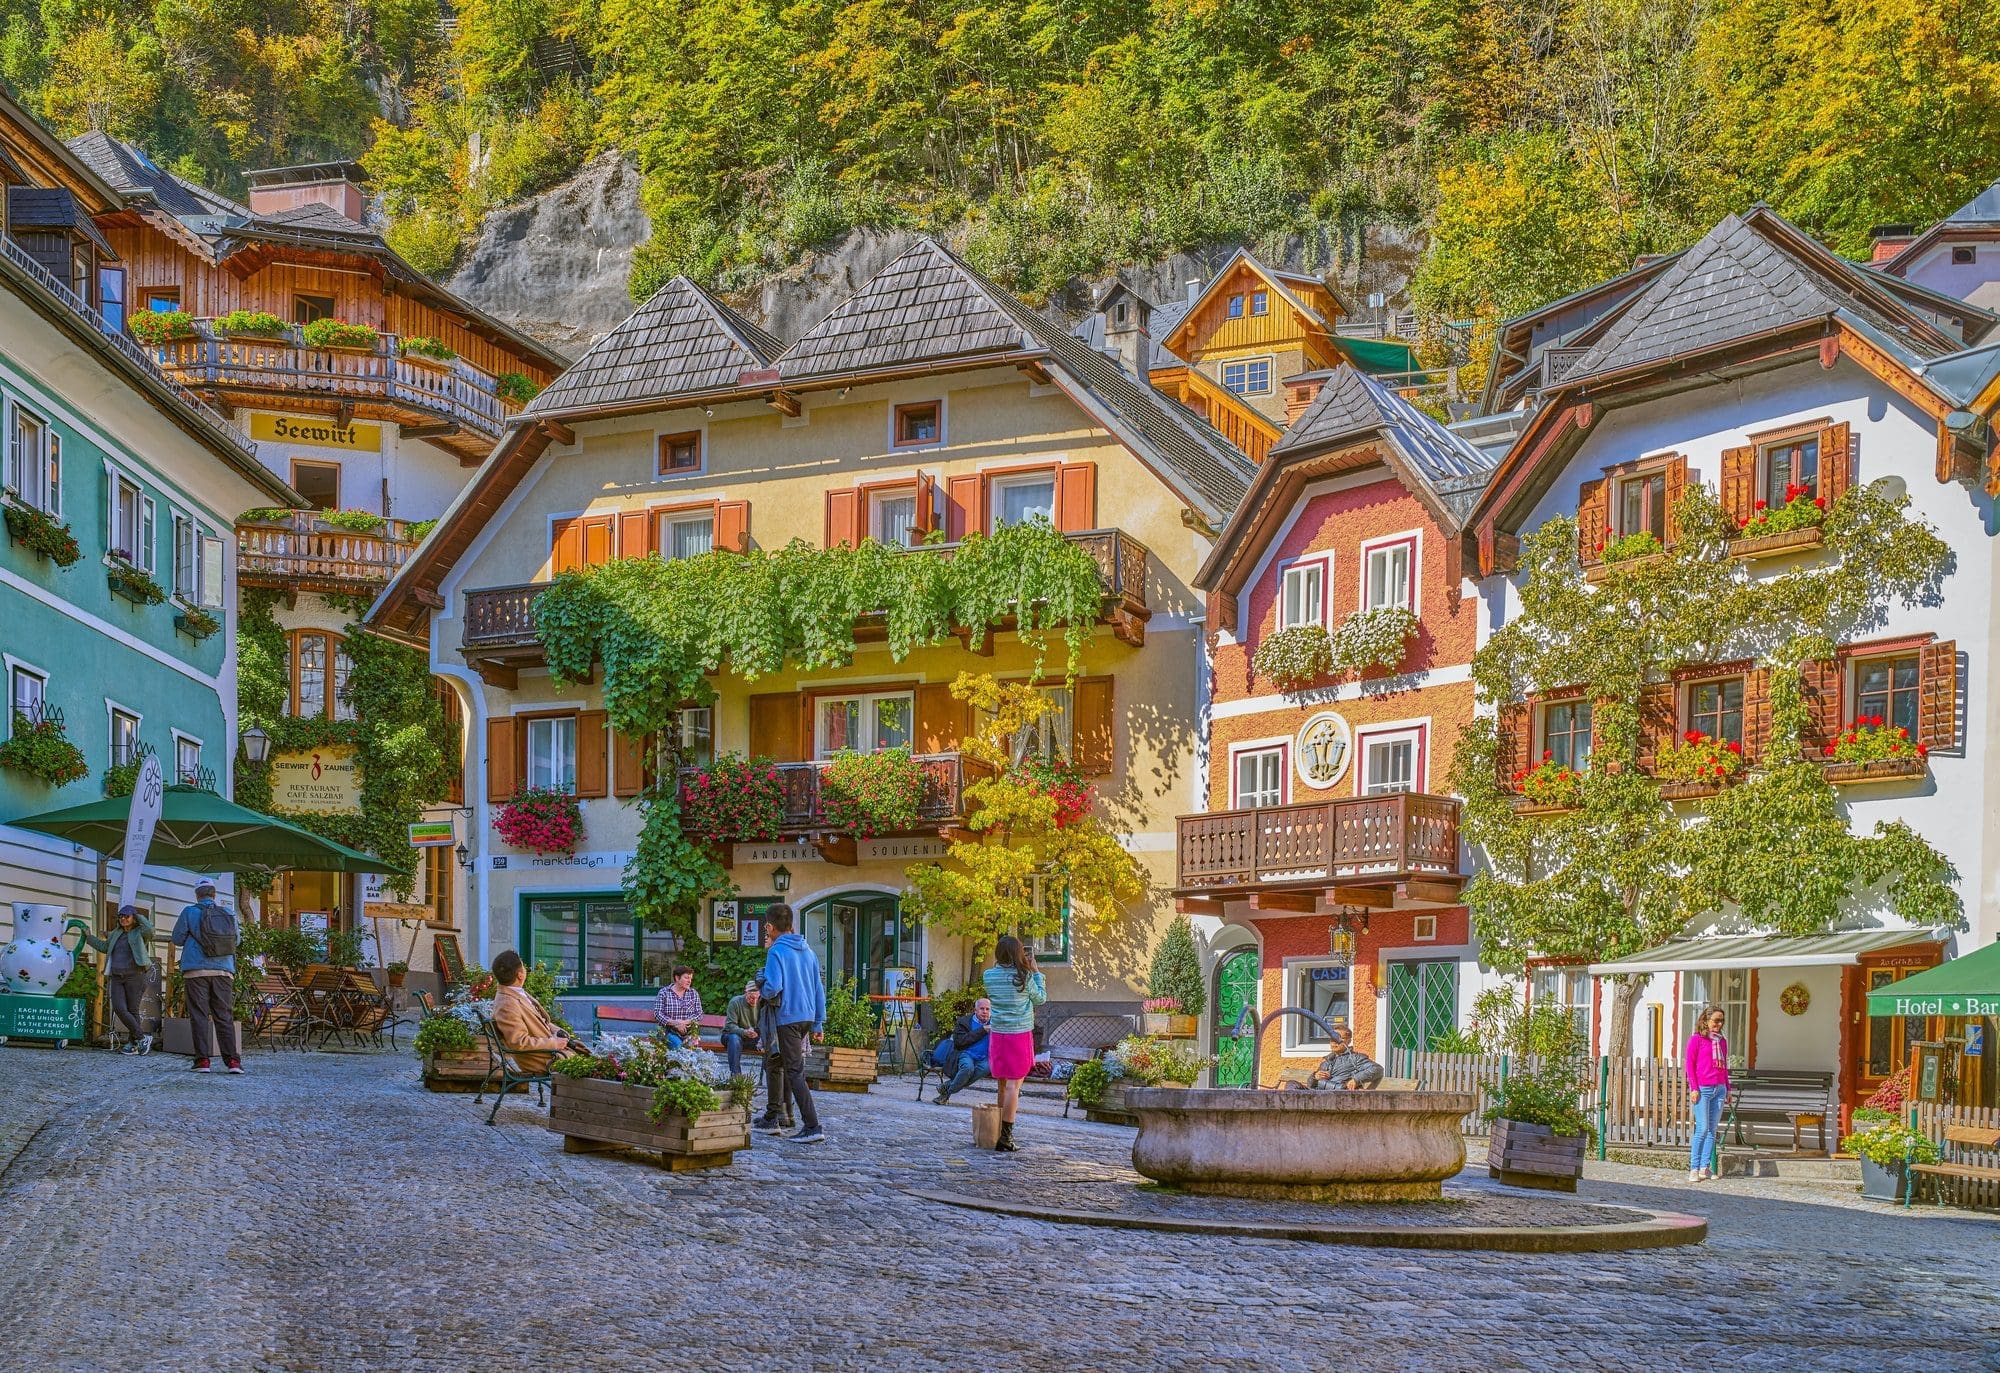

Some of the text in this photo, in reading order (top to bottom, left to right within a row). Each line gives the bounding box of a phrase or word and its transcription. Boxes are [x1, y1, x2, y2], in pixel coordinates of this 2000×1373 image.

[274, 418, 355, 444] Seewirt
[275, 762, 356, 772] SEEWIRT ZAUNER
[289, 784, 341, 792] RESTAURANT
[287, 791, 344, 800] CAFÉ SALZBAR
[752, 848, 817, 860] ANDENKE
[532, 855, 604, 868] marktladen
[1311, 967, 1347, 980] CASH
[1895, 998, 1998, 1015] Hotel Bar
